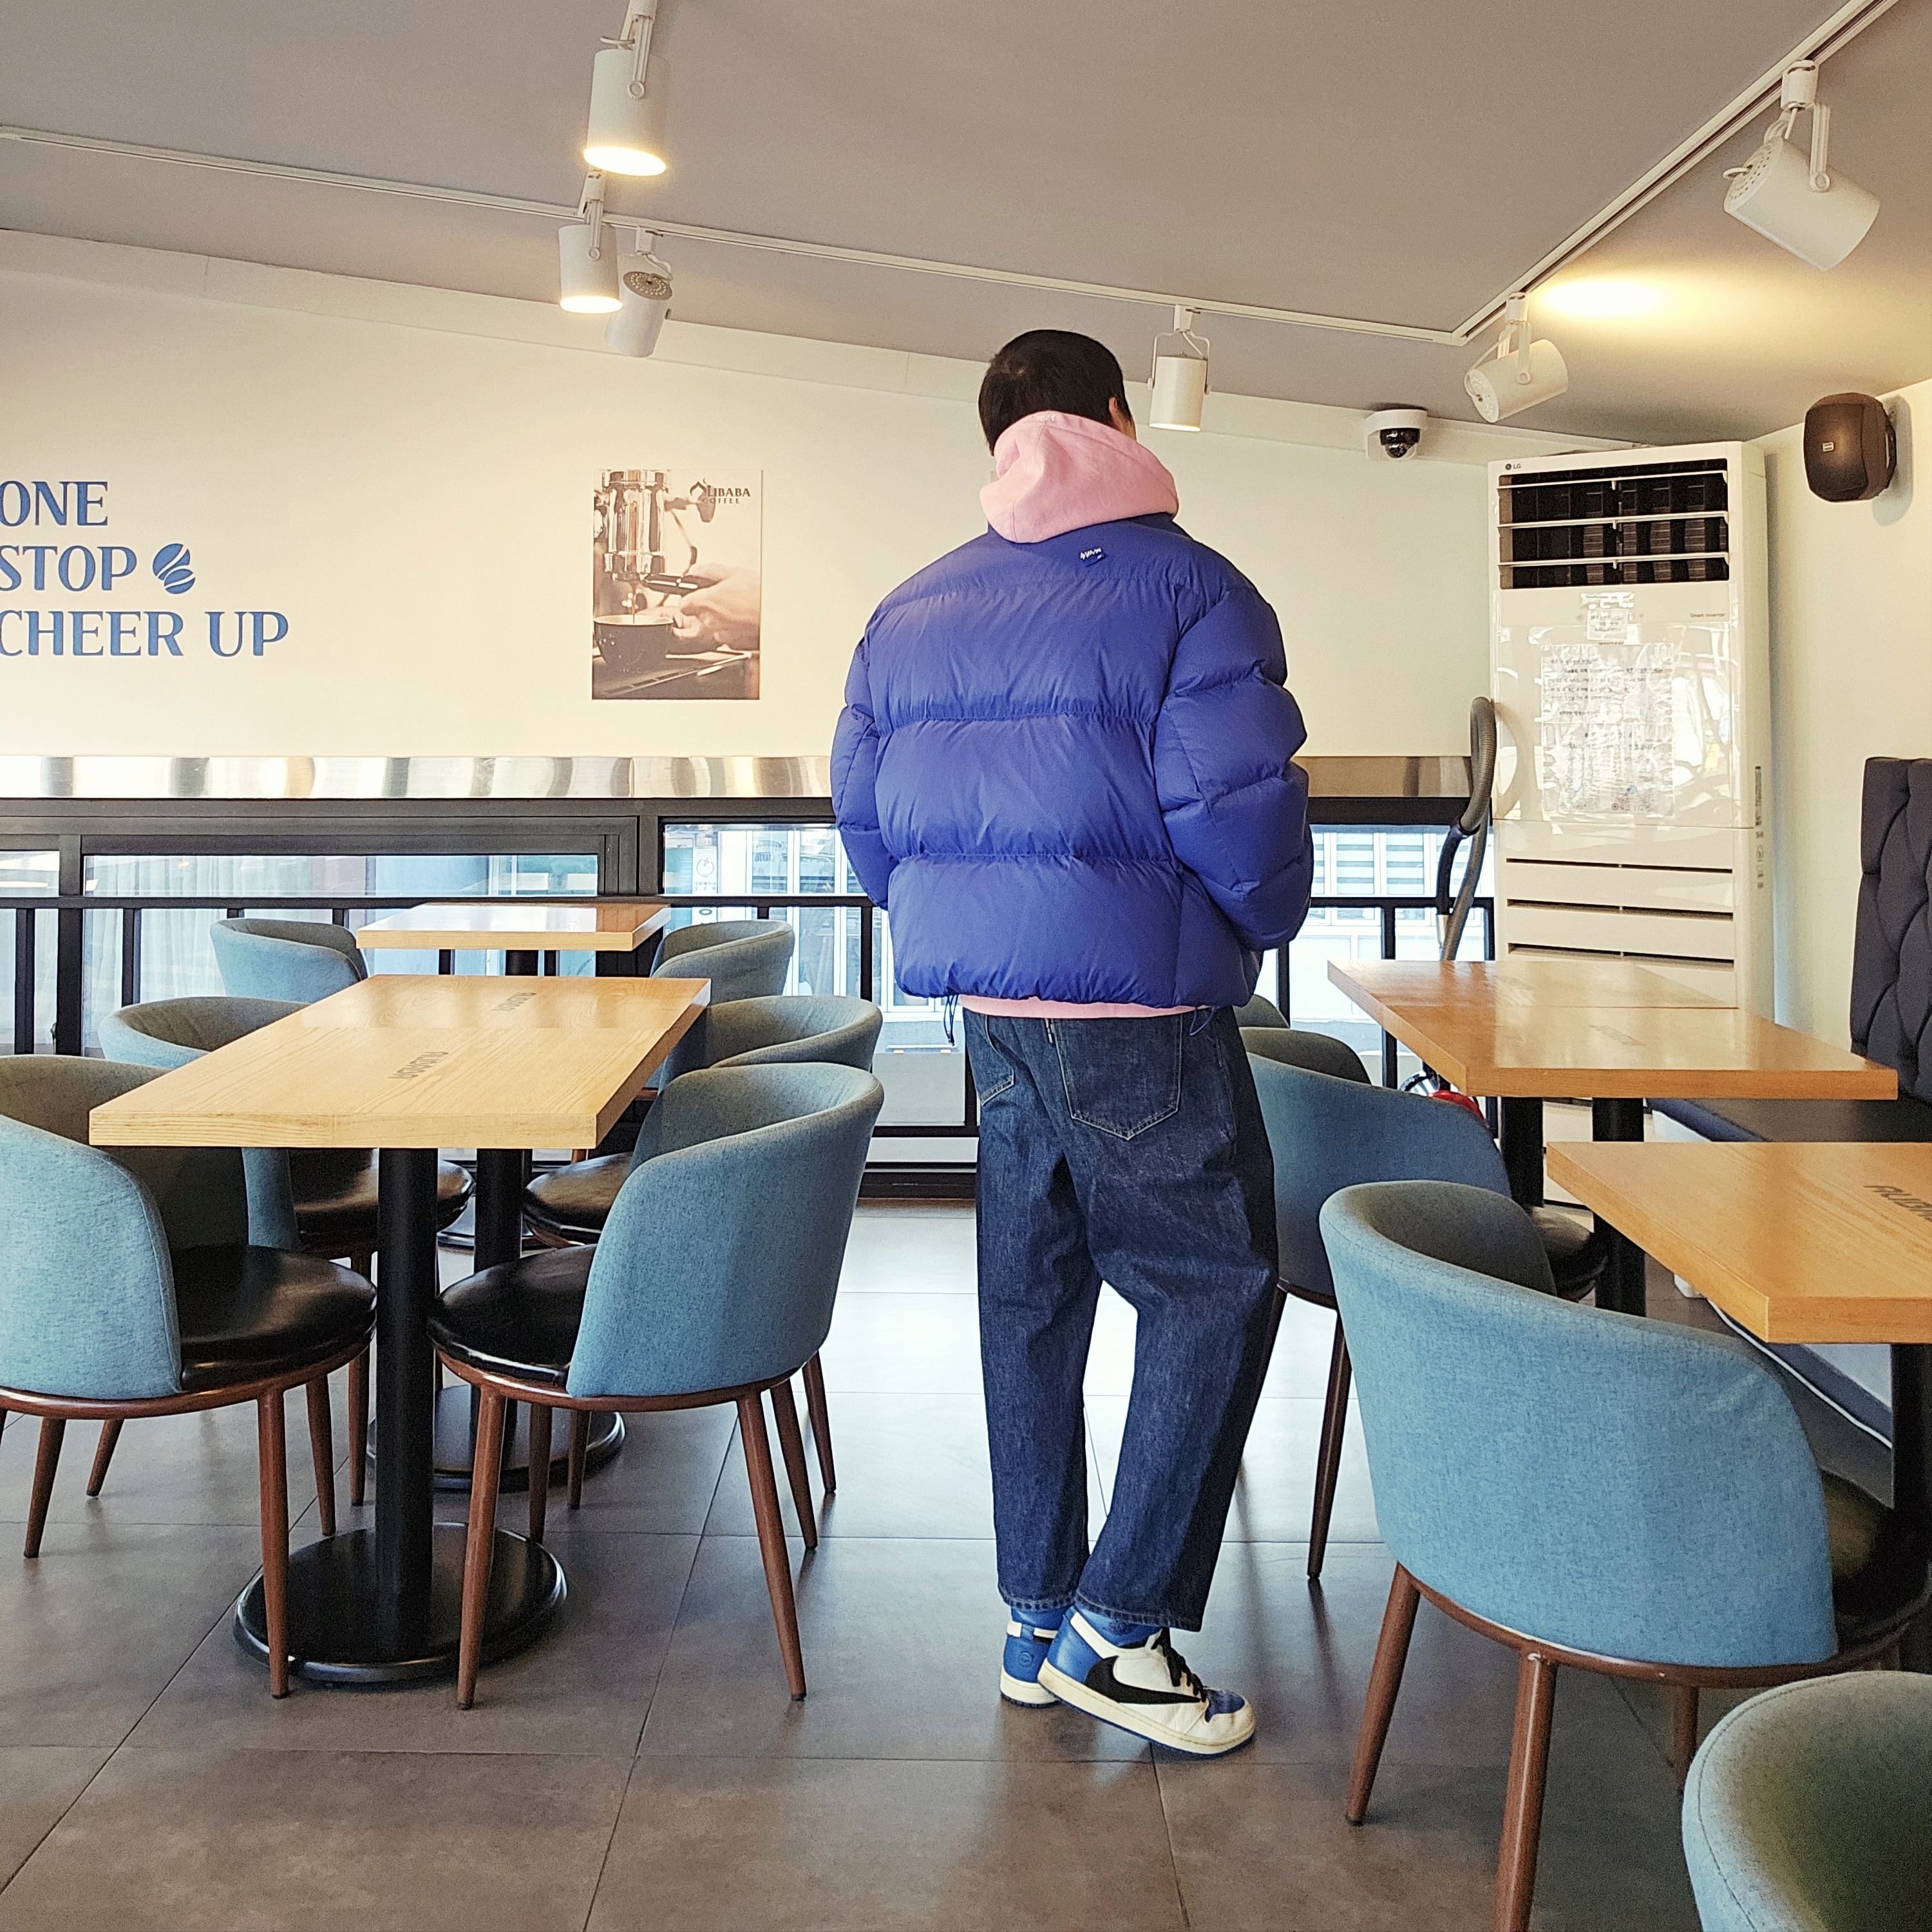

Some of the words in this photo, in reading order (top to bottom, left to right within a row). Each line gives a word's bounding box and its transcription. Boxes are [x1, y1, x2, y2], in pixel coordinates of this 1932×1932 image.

[0, 480, 108, 527] ONE
[0, 545, 137, 592] STOP
[0, 609, 184, 657] CHEER
[205, 611, 289, 658] UP
